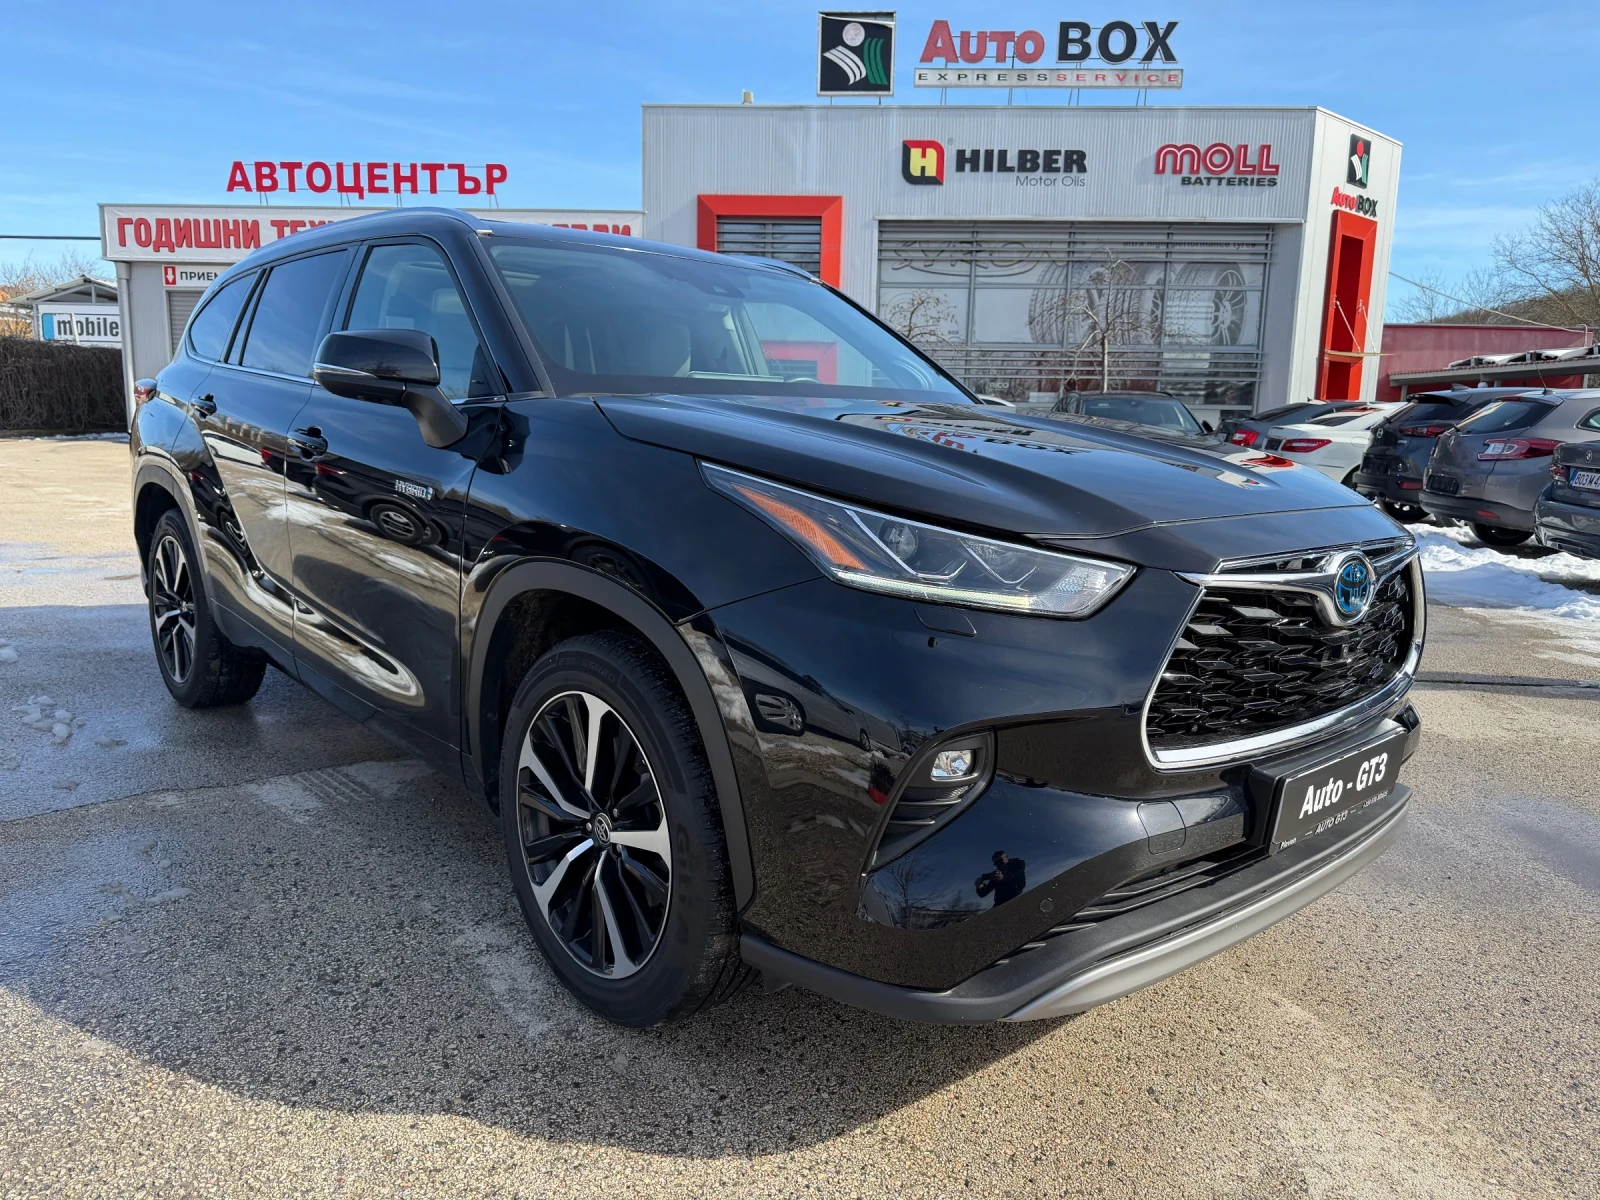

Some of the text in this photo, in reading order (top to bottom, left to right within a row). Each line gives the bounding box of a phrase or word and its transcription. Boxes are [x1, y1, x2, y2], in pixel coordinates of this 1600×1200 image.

[1056, 20, 1179, 65] BOX
[955, 149, 1088, 173] HILBER
[1154, 143, 1280, 175] MOLL
[226, 161, 507, 200] АВТОЦЕНТЪР
[1015, 176, 1086, 188] Motor Oils
[1180, 177, 1278, 187] BATTERIES
[117, 217, 260, 252] ГОДИШНИ
[57, 316, 120, 337] mobile
[395, 480, 427, 499] HYBRID
[1299, 778, 1344, 820] Auto
[1356, 752, 1388, 792] GT3
